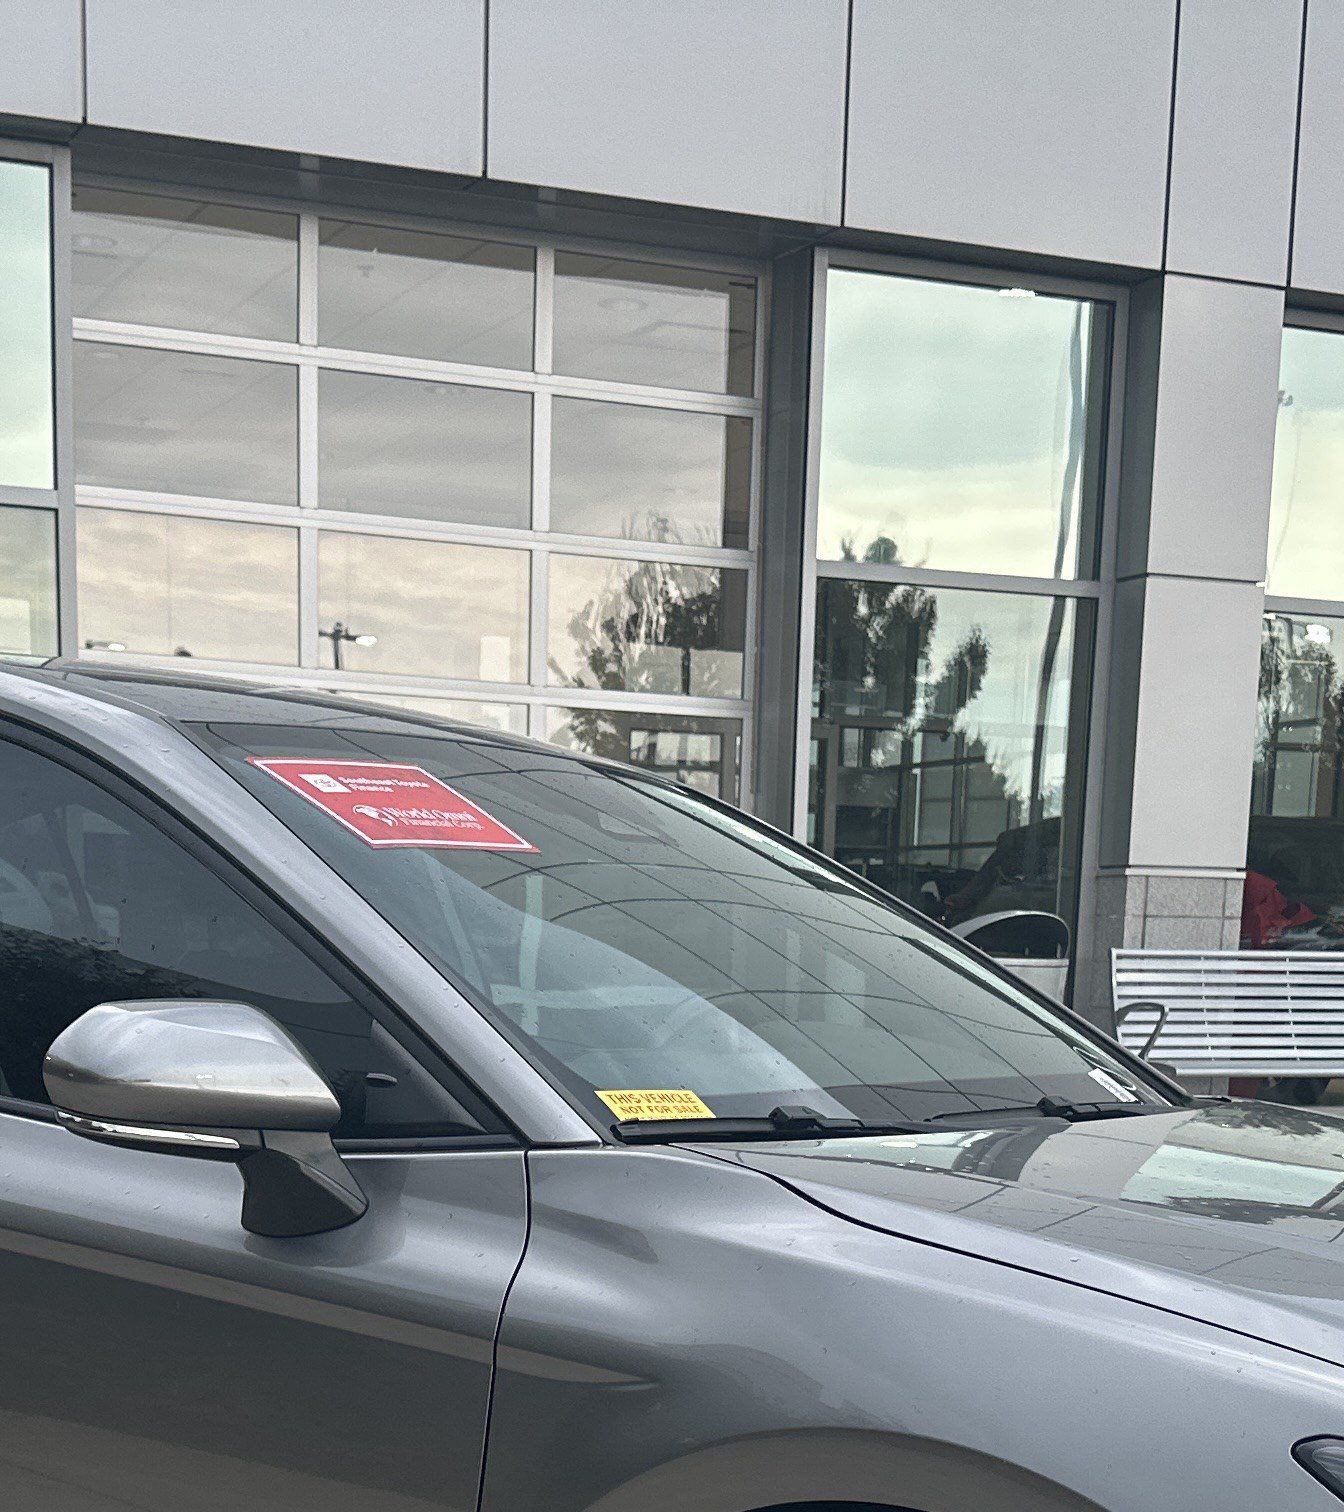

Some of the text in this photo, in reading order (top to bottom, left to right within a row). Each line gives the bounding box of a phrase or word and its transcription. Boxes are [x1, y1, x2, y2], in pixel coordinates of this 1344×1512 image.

[387, 807, 436, 819] World
[399, 817, 455, 827] Financial
[606, 1093, 696, 1104] THIS VEHICLE
[619, 1105, 703, 1114] NOT FOR SALE
